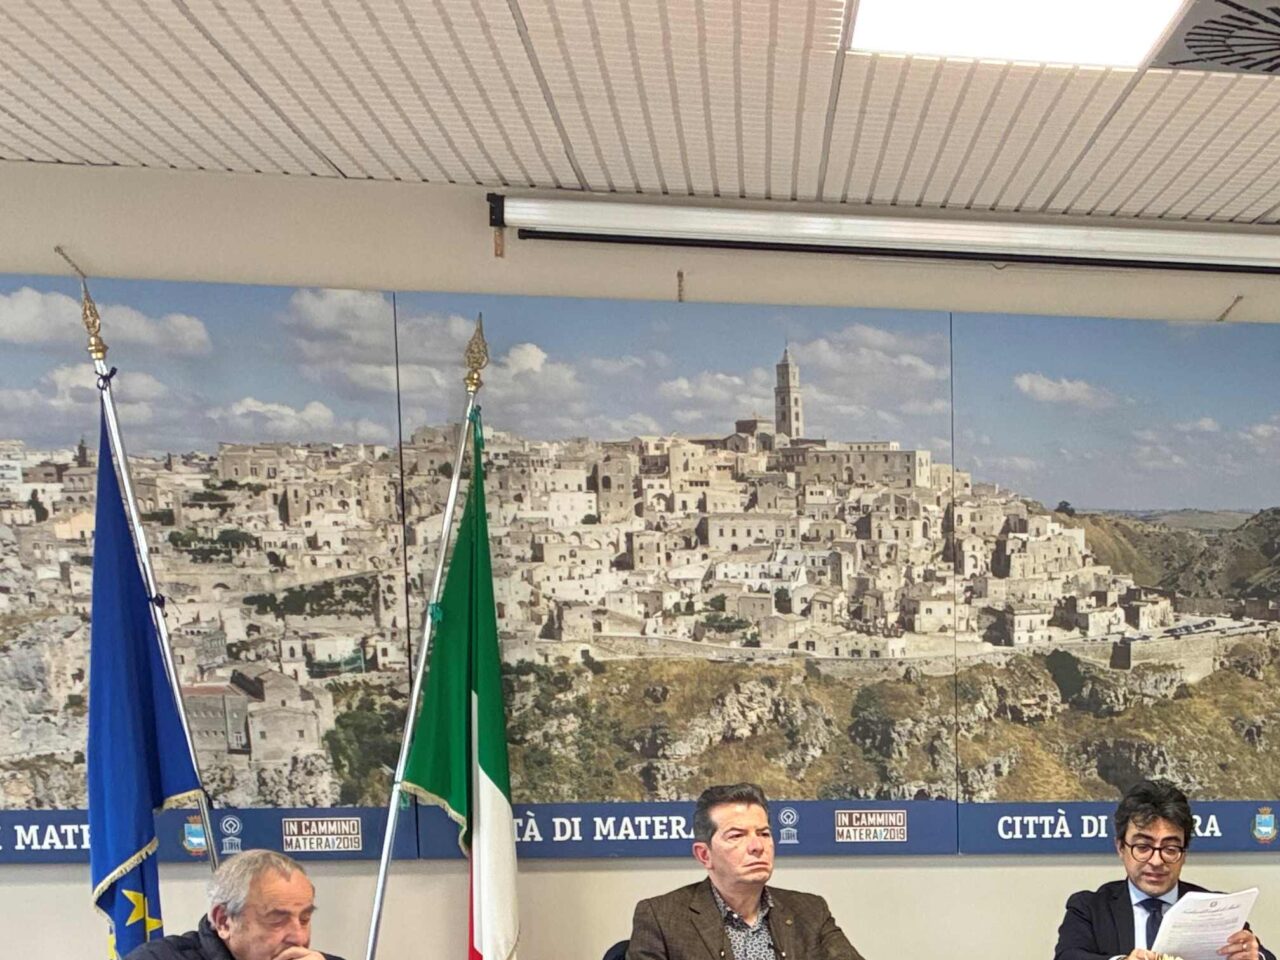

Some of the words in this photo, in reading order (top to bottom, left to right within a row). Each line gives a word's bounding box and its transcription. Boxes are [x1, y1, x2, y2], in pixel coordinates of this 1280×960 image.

[837, 812, 849, 826] IN
[852, 812, 905, 826] CAMMINO
[997, 808, 1072, 840] CITTÀ
[1080, 815, 1108, 838] DI
[284, 821, 298, 836] IN
[301, 820, 358, 836] CAMMINO
[552, 816, 583, 842] DI
[836, 828, 878, 841] MATERA
[883, 828, 906, 840] 2019
[284, 837, 334, 851] MATERA
[336, 836, 360, 850] 2019
